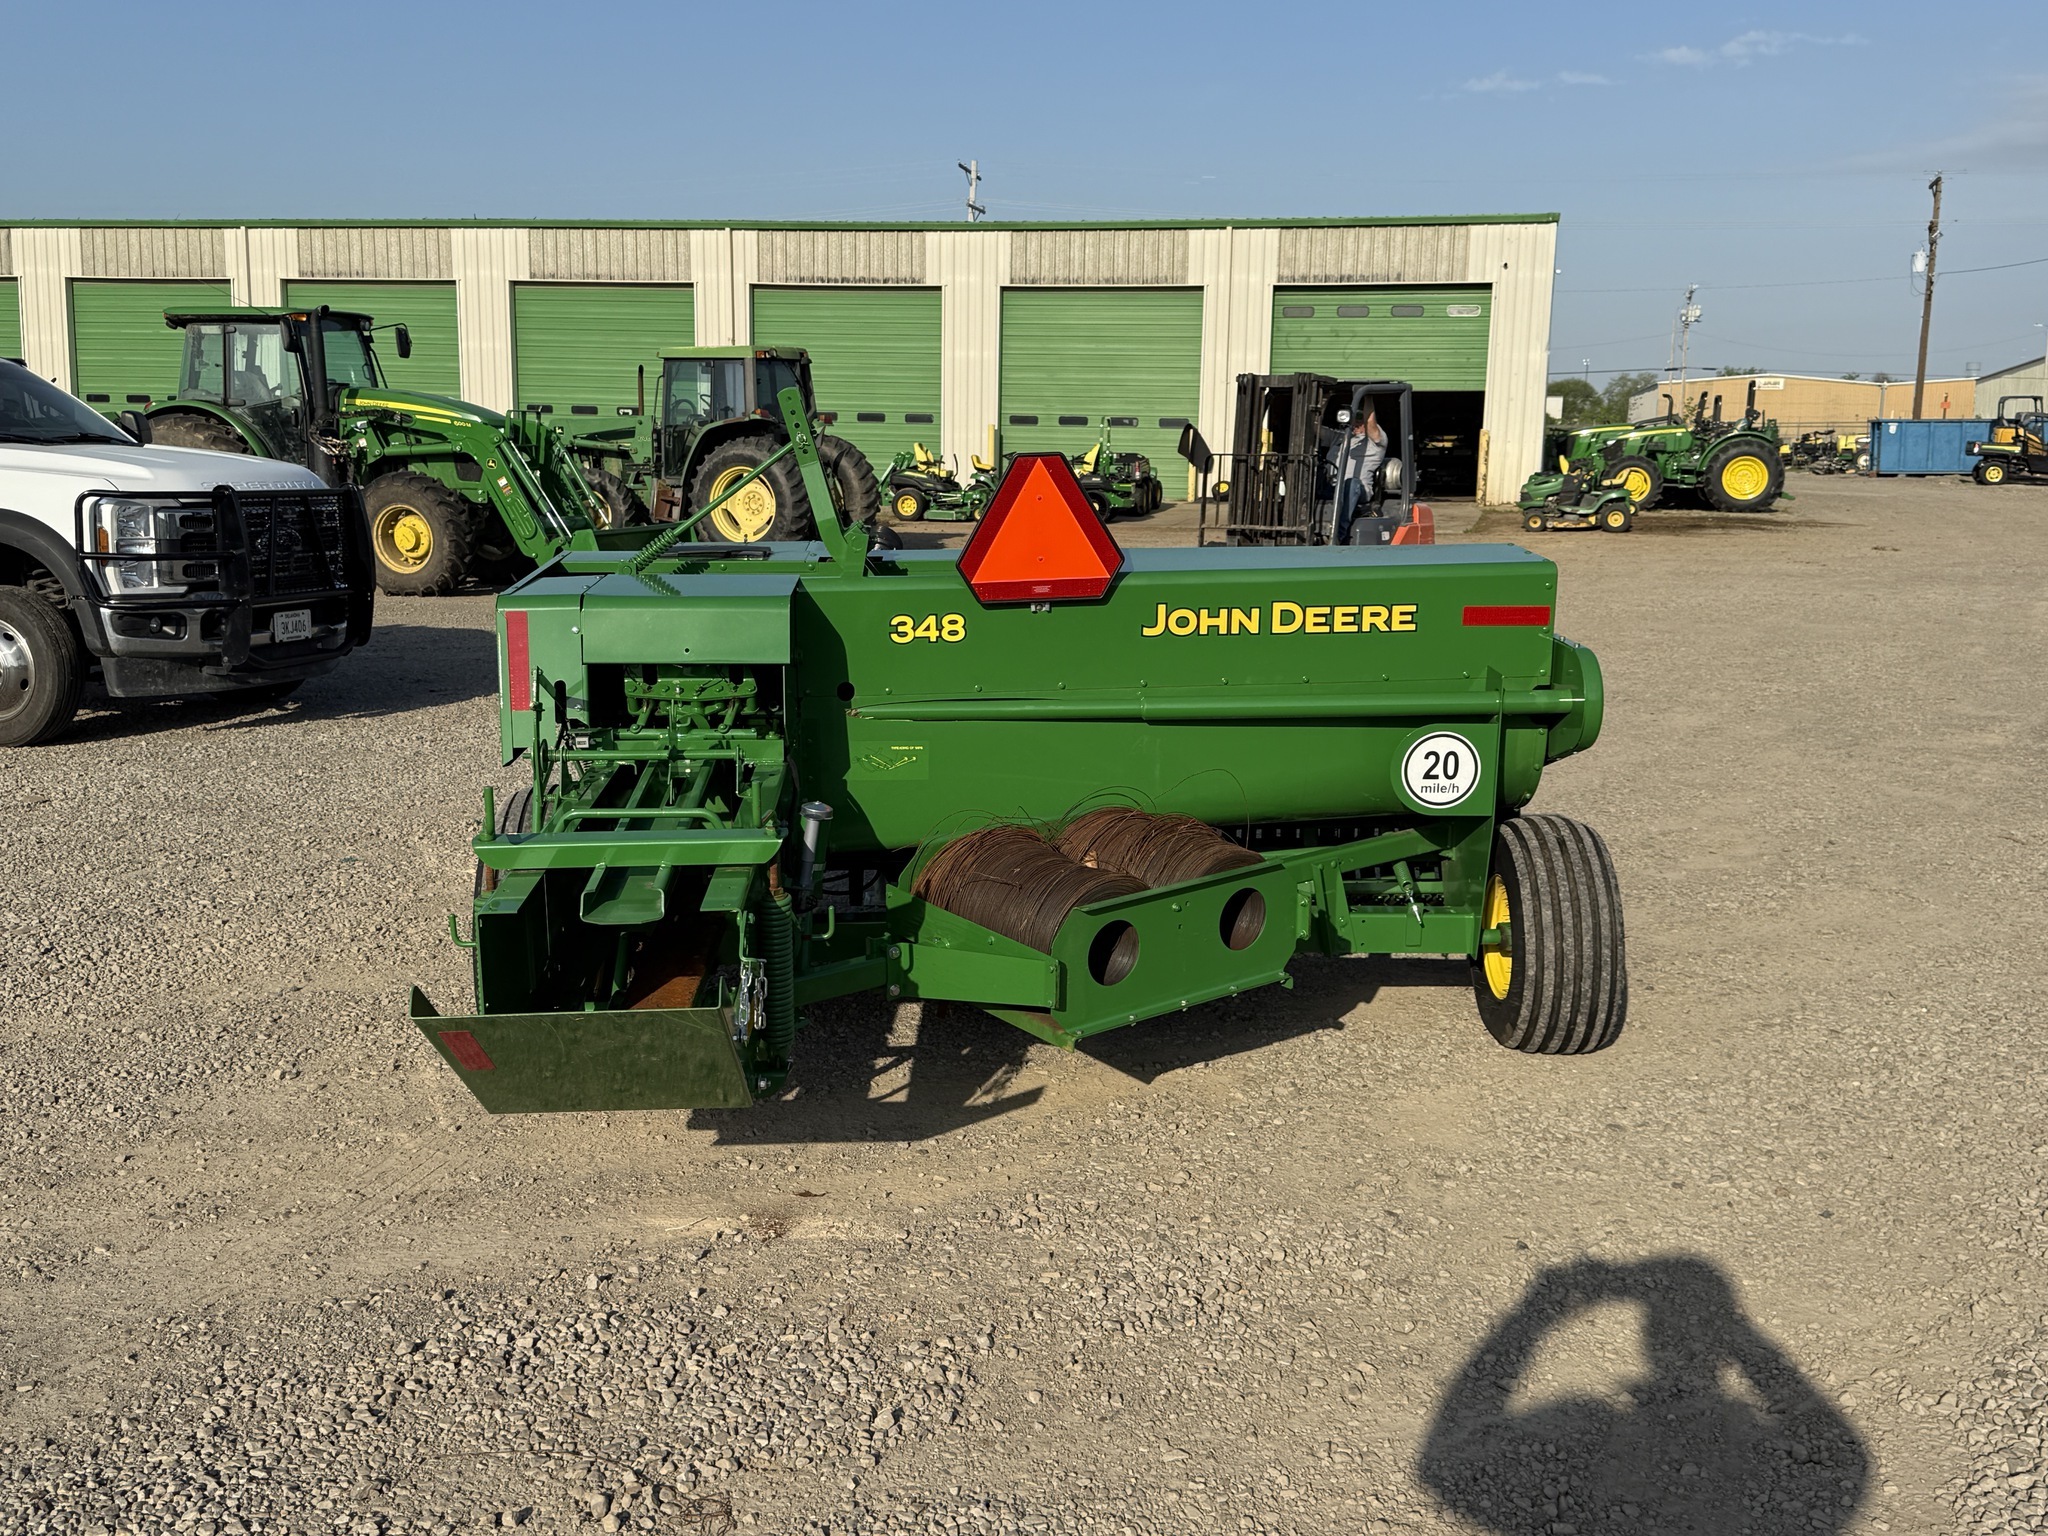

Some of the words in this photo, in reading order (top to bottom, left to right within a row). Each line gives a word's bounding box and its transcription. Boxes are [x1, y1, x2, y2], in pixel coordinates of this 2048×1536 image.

[889, 612, 967, 645] 348
[1141, 603, 1261, 637] JOHN
[1270, 601, 1418, 635] DEERE
[1422, 750, 1460, 780] 20
[1420, 783, 1460, 794] mile/h
